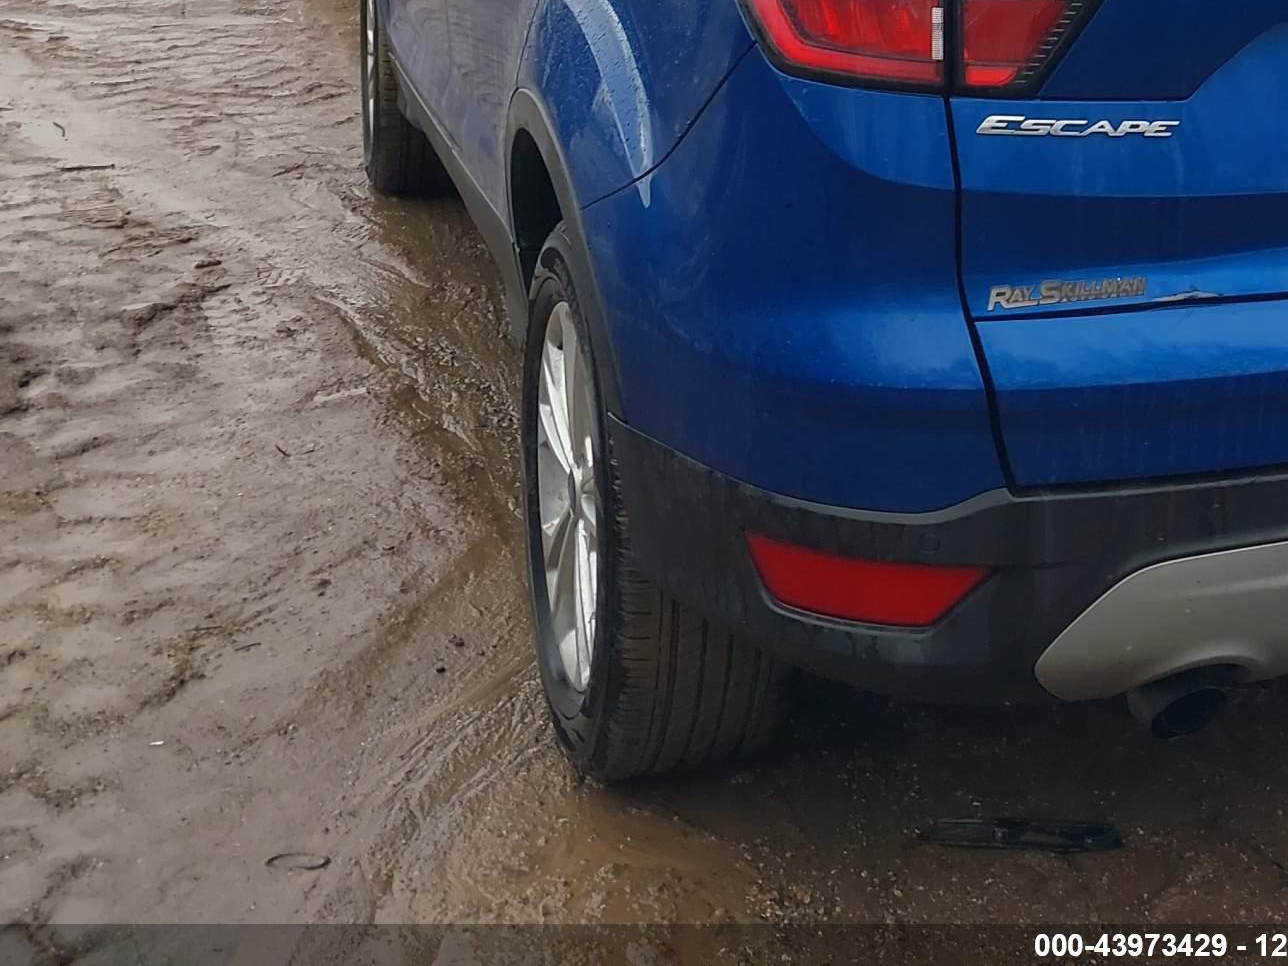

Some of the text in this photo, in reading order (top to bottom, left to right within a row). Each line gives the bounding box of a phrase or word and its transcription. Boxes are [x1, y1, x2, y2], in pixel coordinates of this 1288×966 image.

[976, 115, 1181, 137] ESCAPE
[987, 277, 1147, 311] RAY SKILLMAN
